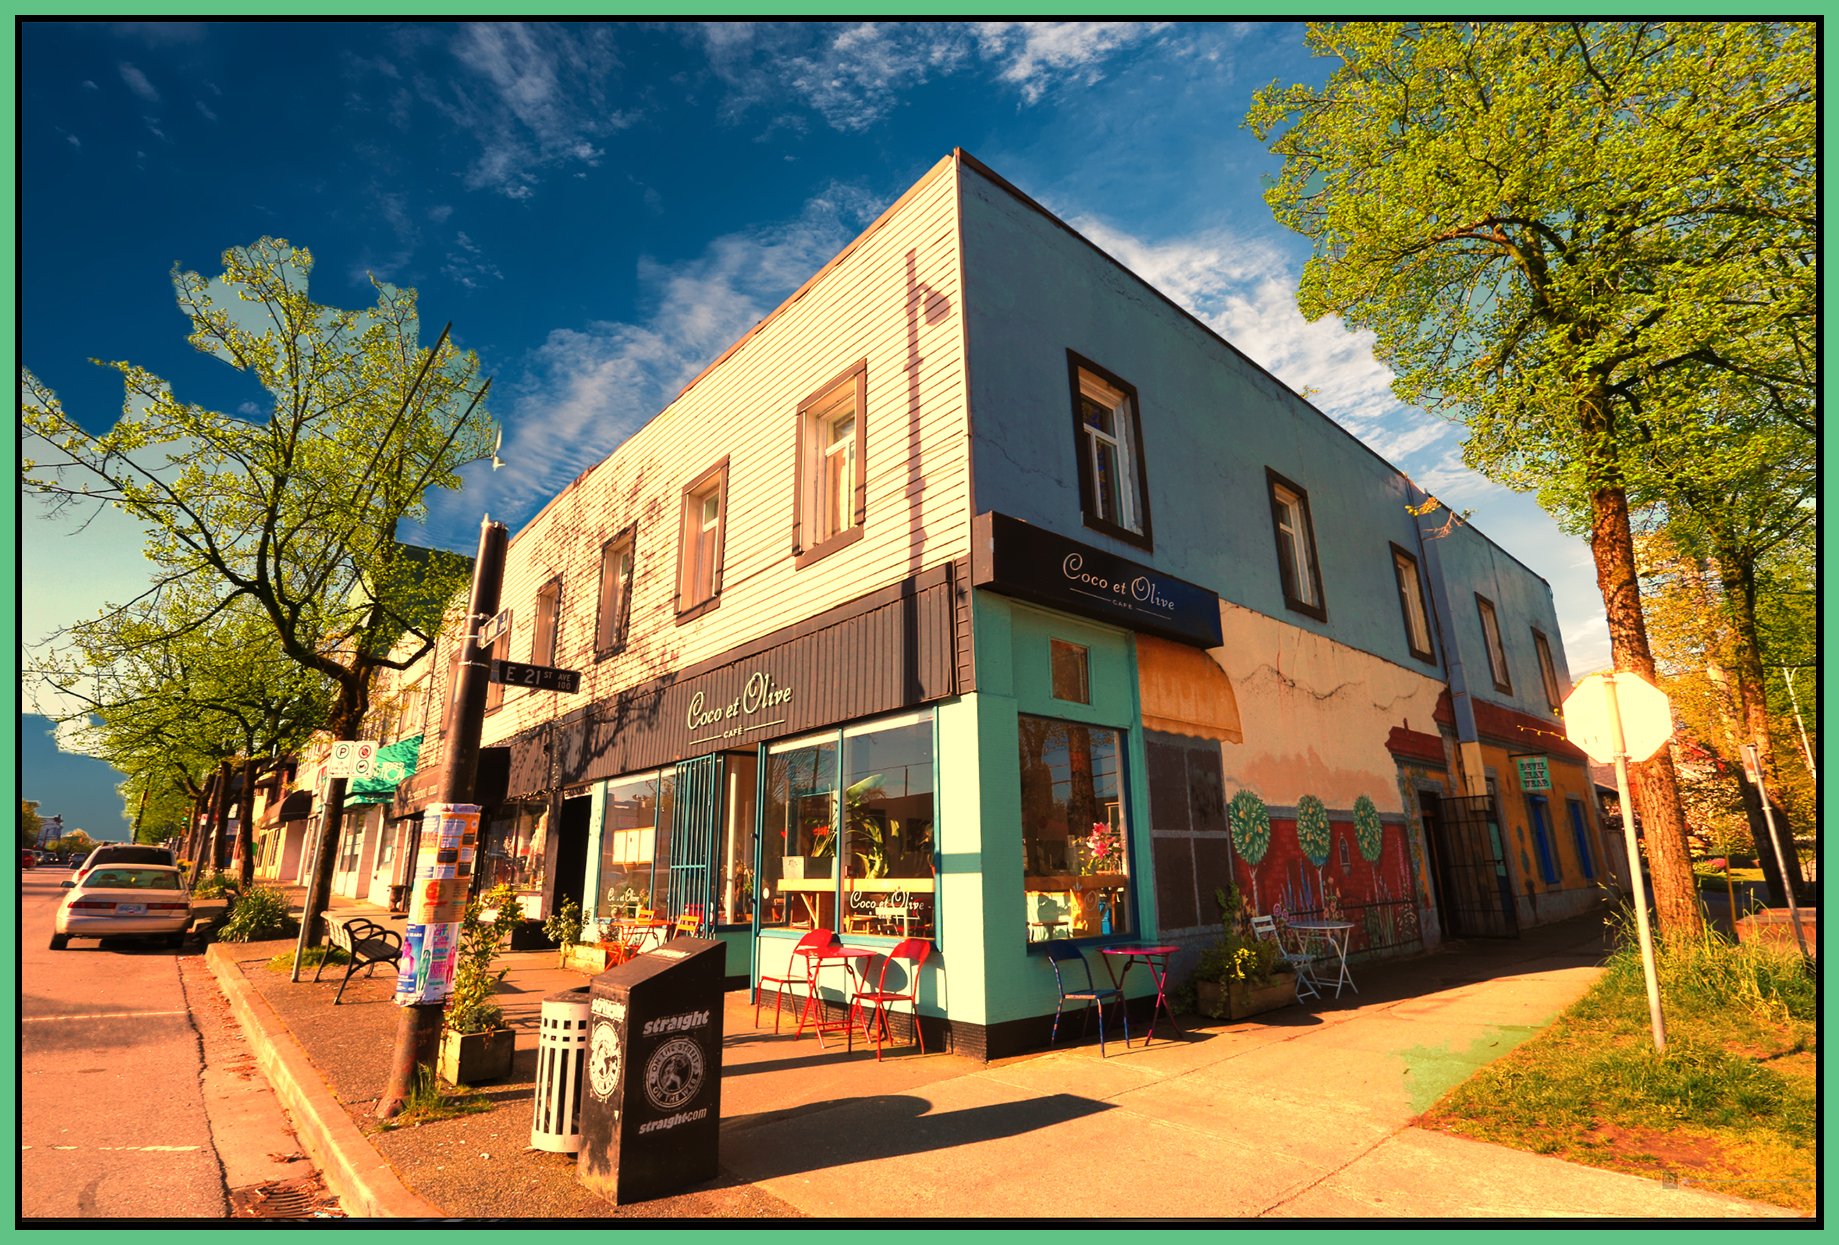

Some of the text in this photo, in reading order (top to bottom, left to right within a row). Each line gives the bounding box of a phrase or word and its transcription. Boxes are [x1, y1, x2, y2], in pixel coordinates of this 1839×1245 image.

[1063, 553, 1175, 610] Coco et Olive
[506, 666, 517, 682] E
[557, 673, 572, 681] AVE
[557, 681, 571, 690] 100
[687, 672, 792, 730] Coco et Olive
[849, 890, 876, 909] Coco
[891, 889, 925, 910] Olive
[643, 1009, 710, 1035] straight
[678, 1043, 699, 1065] STREET
